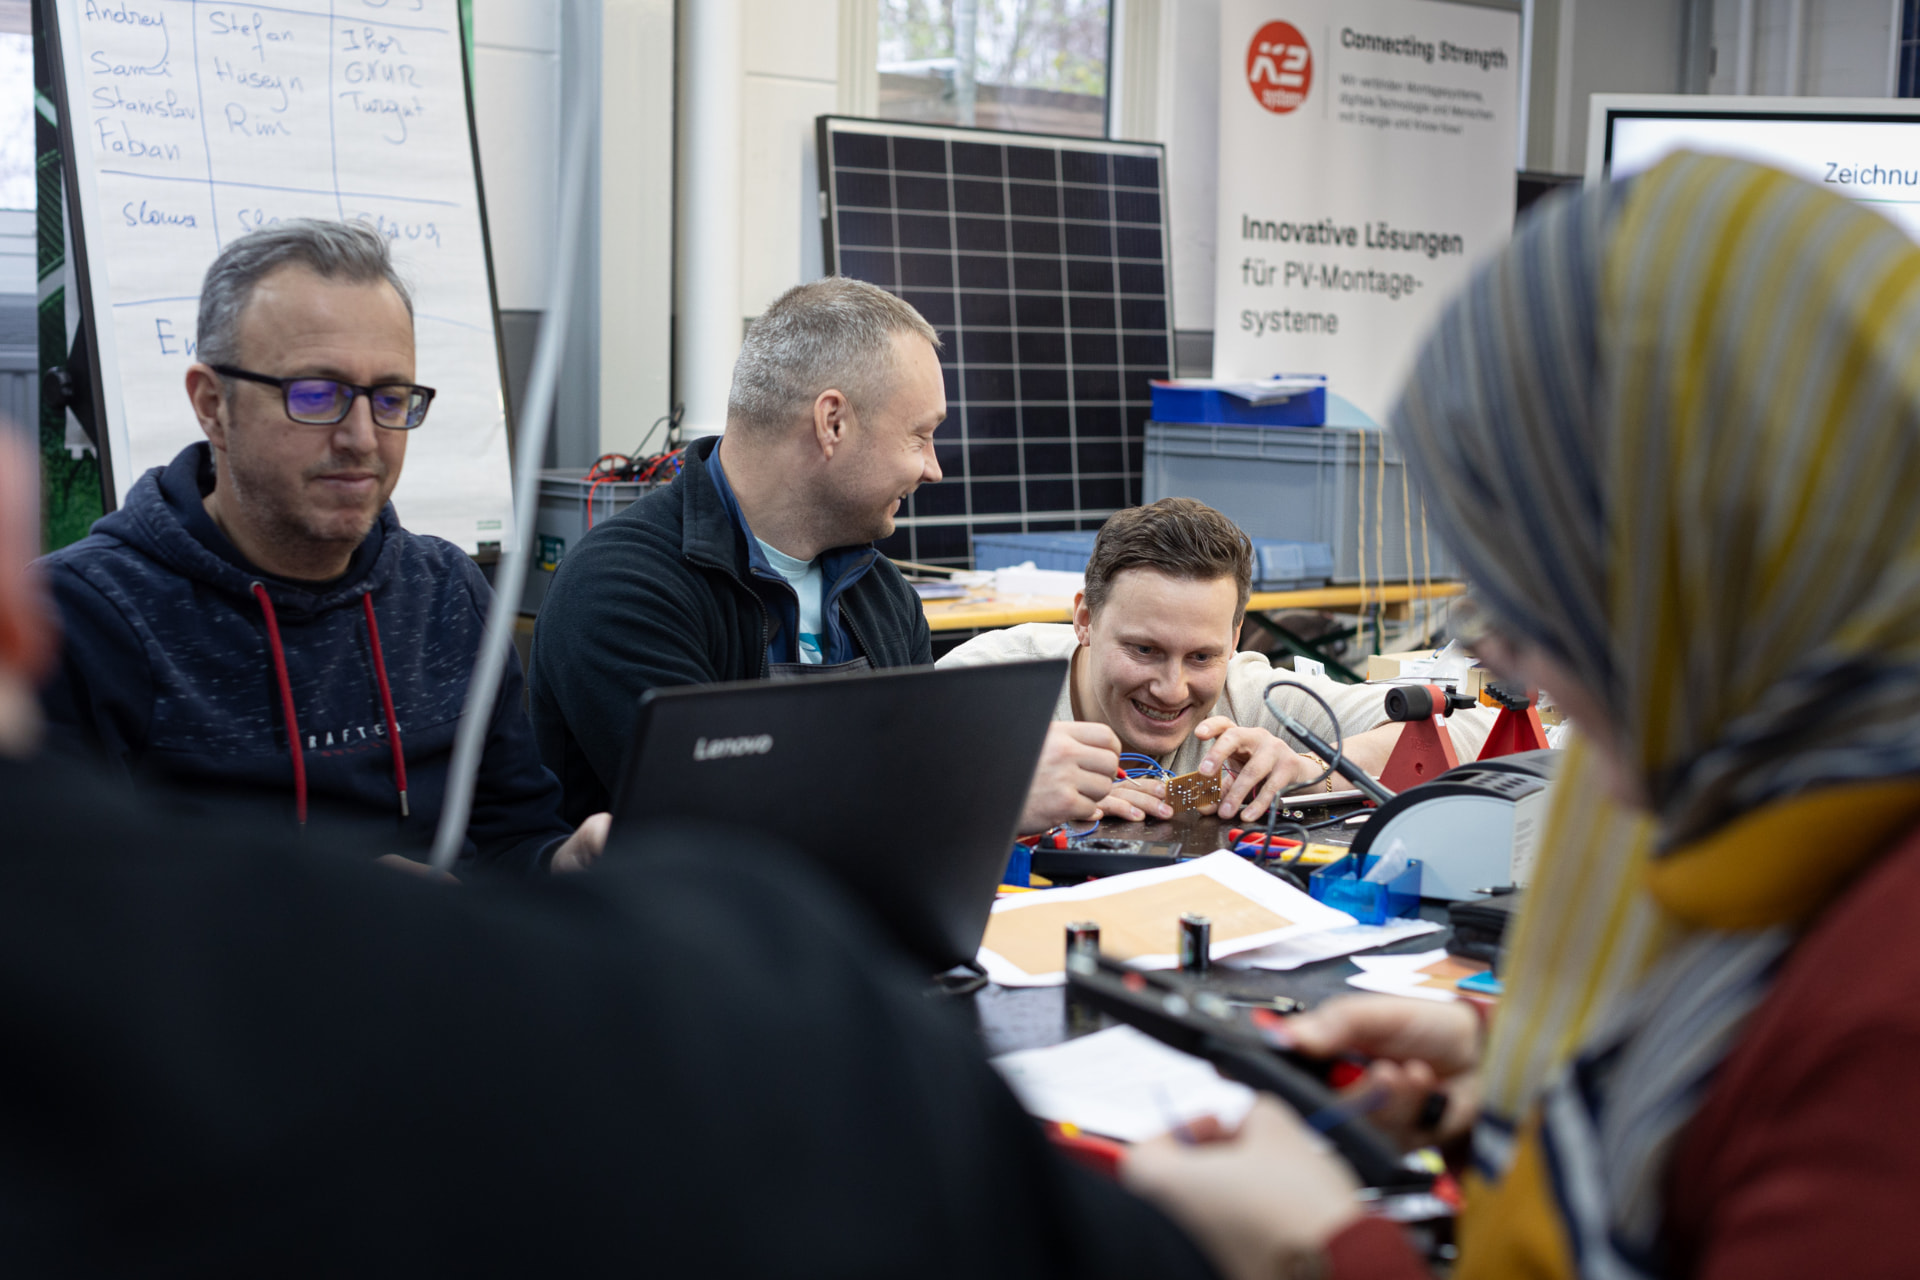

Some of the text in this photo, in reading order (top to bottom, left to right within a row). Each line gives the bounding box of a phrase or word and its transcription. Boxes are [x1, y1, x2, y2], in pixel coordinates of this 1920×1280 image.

[209, 11, 294, 62] Stefan
[1341, 27, 1508, 72] Connecting Strength
[1824, 162, 1920, 185] Zeichnu
[1241, 214, 1464, 259] Innovative Lösungen
[1241, 257, 1424, 301] für PV-Montage-
[1240, 307, 1340, 337] systeme
[693, 734, 774, 762] Lenovo
